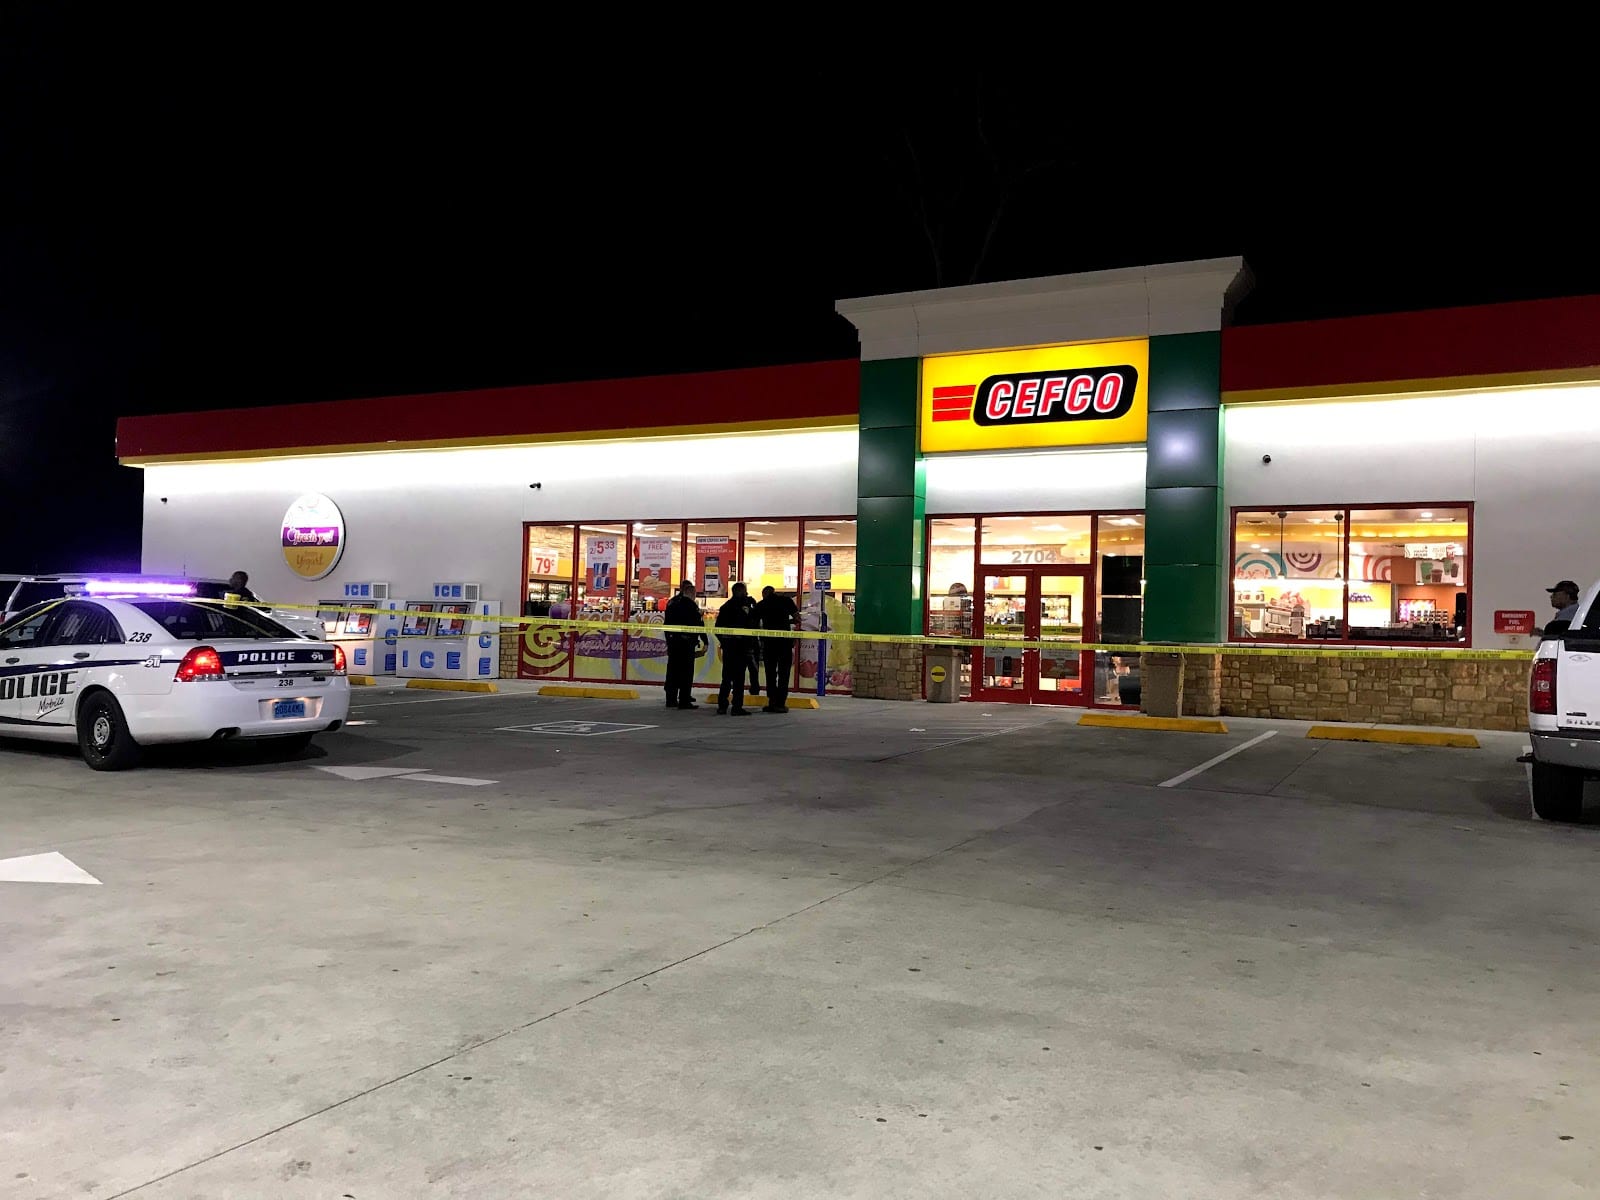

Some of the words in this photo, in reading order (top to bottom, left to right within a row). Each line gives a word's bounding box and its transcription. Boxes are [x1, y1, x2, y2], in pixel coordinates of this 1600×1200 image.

[985, 372, 1124, 420] CEFCO
[1012, 550, 1057, 563] 2704
[345, 584, 369, 596] ICE
[434, 585, 461, 597] ICE
[129, 632, 152, 643] 238
[238, 651, 296, 662] POLICE
[402, 650, 461, 670] ICE
[278, 679, 294, 687] 238
